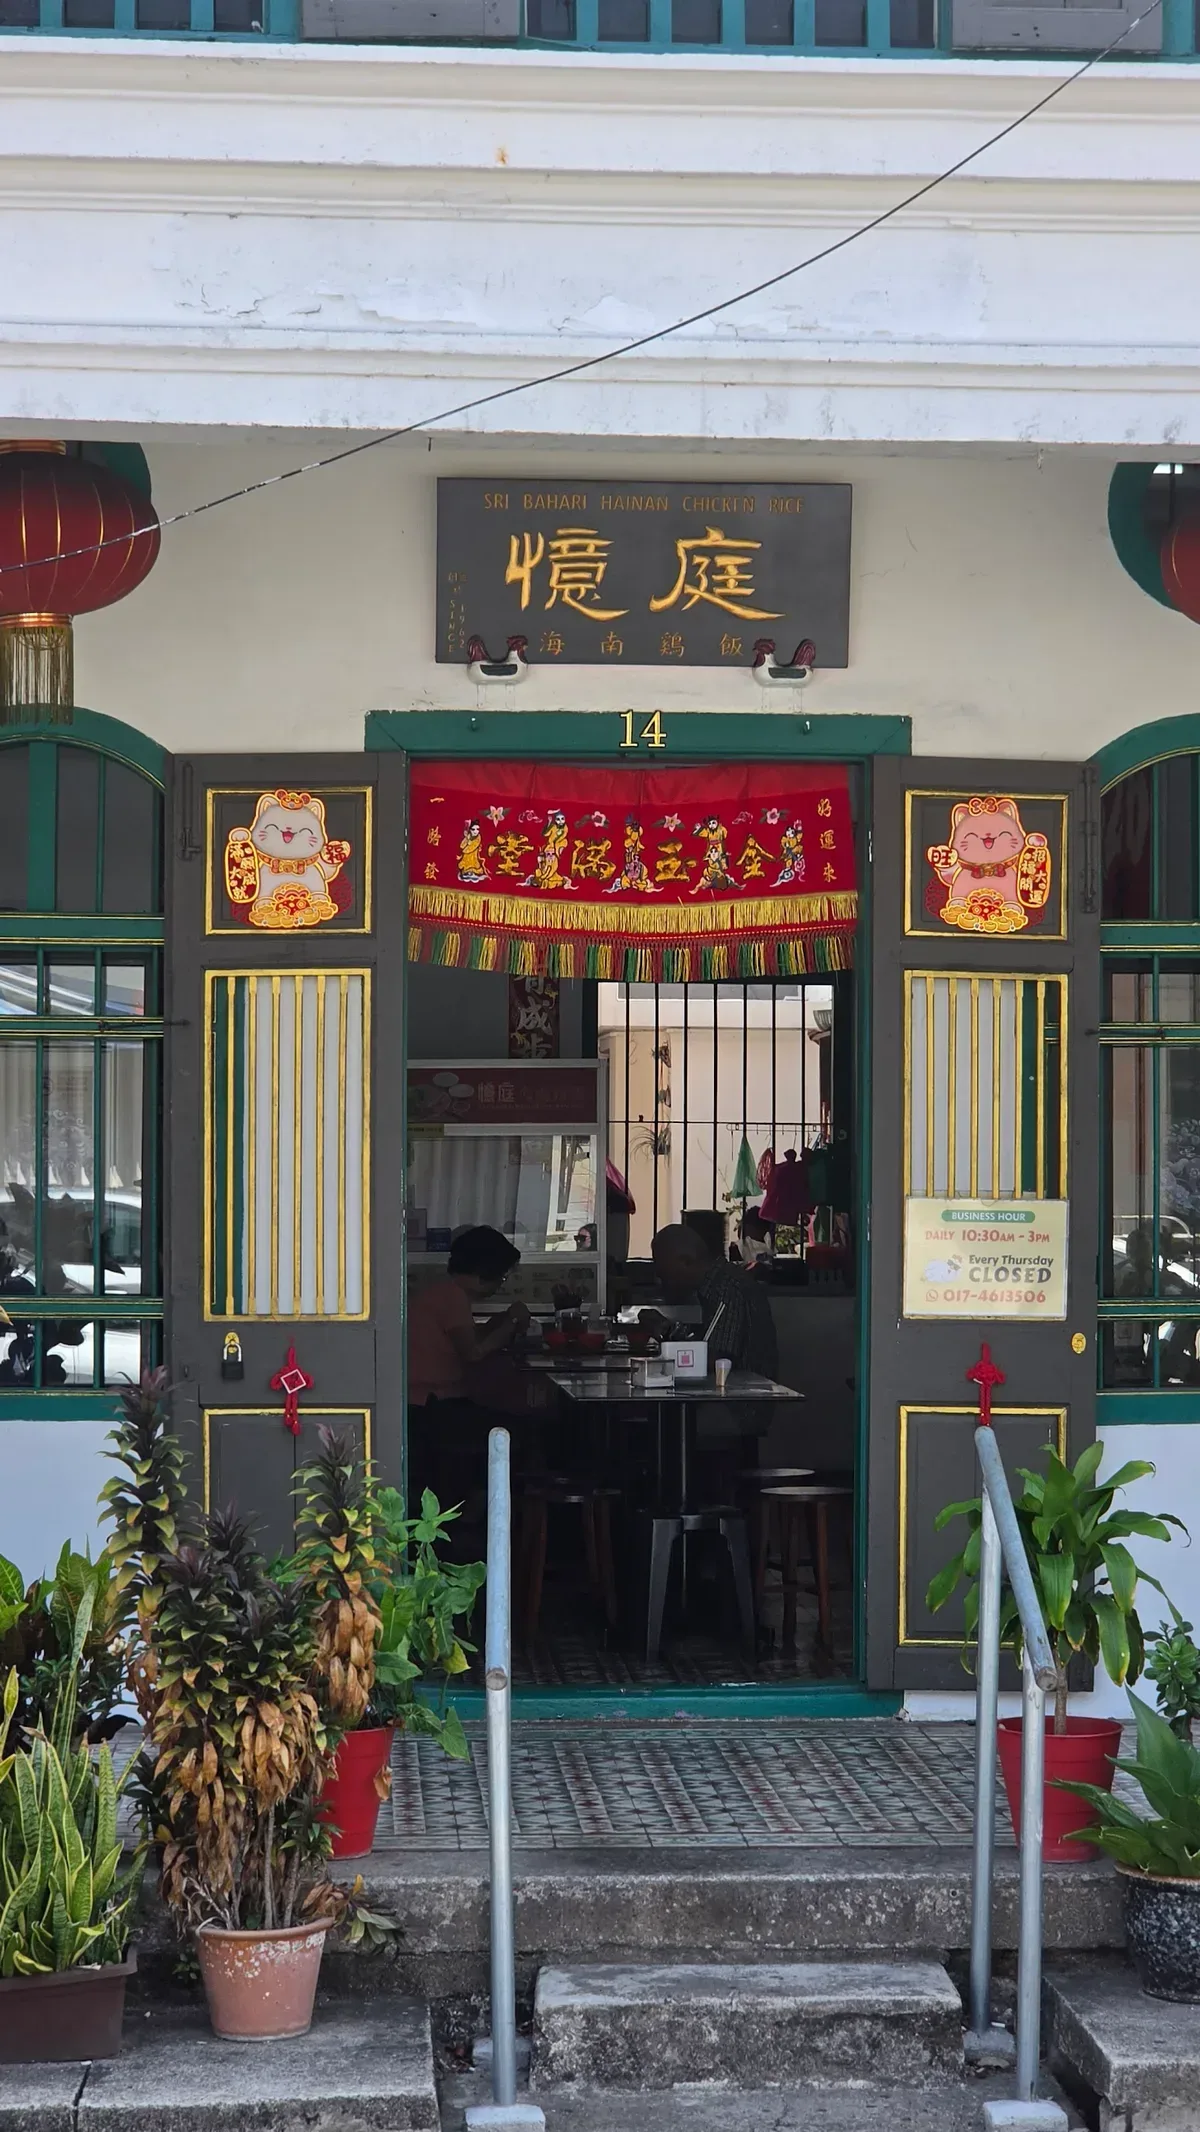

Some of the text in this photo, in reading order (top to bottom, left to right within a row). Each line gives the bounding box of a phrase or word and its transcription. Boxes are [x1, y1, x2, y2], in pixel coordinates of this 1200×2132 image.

[484, 493, 509, 509] SRI
[523, 493, 587, 510] BAHARI
[601, 495, 669, 511] HAINAN
[769, 498, 804, 513] RICE
[504, 525, 786, 621] 憶庭
[619, 709, 668, 748] 14
[324, 845, 347, 864] 福
[931, 850, 952, 866] 旺
[951, 1211, 1026, 1221] BUSINESS HOUR
[925, 1230, 955, 1240] DAILY
[962, 1229, 1015, 1242] 10:30AM
[1028, 1230, 1050, 1243] 3PM
[969, 1254, 1054, 1267] Every Thursday
[969, 1266, 1052, 1283] CLOSED
[943, 1289, 1046, 1303] 017-4613506
